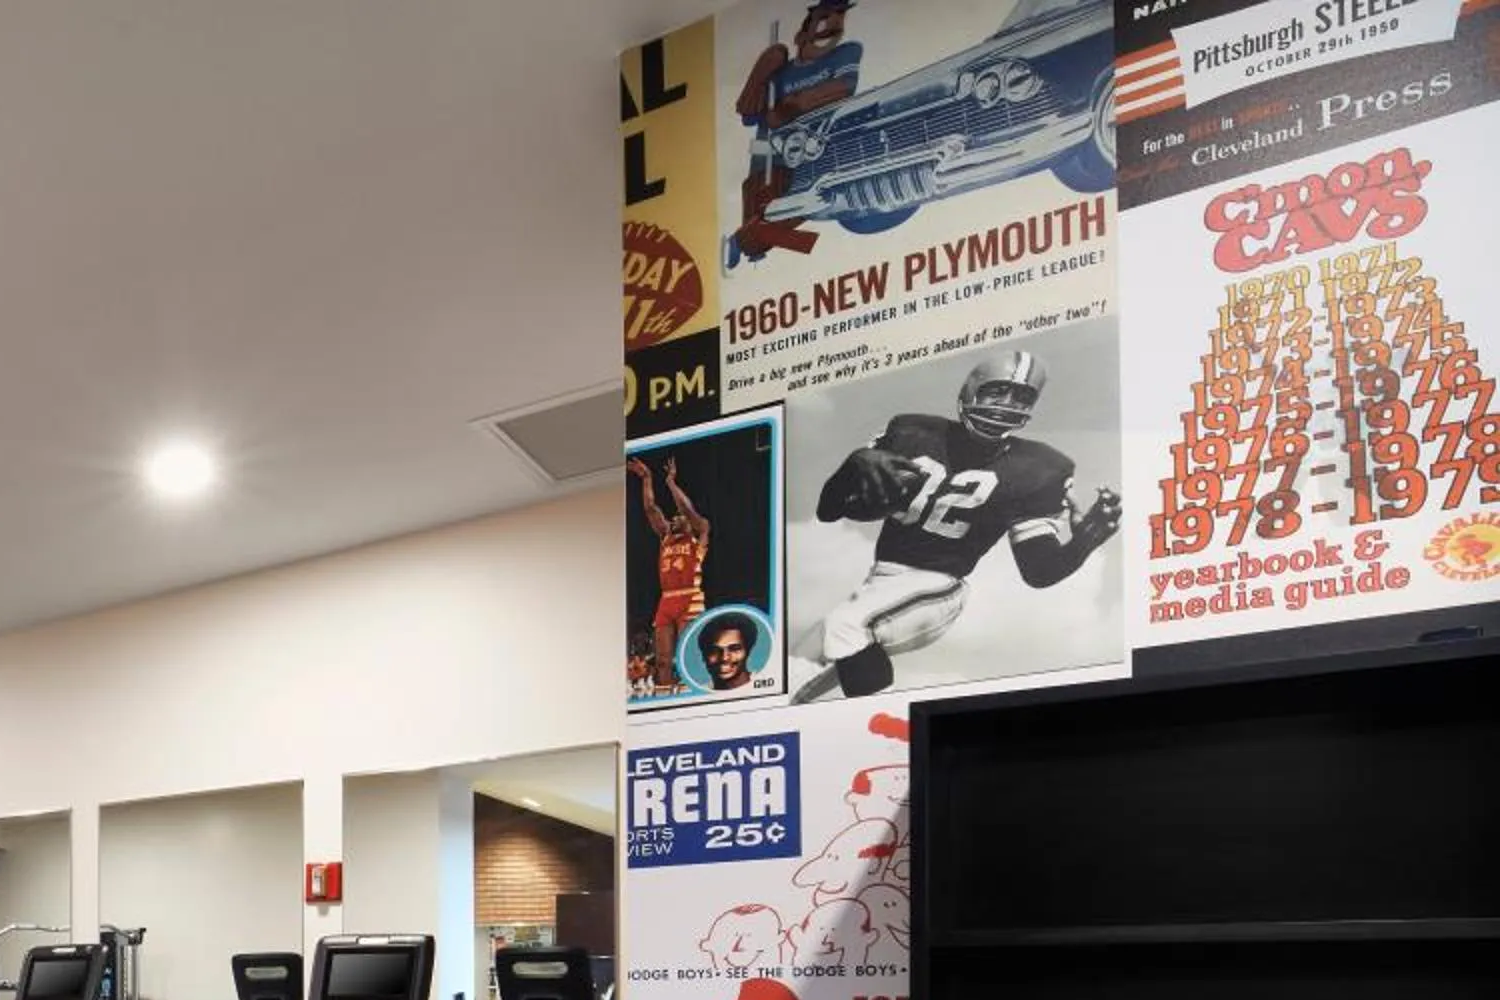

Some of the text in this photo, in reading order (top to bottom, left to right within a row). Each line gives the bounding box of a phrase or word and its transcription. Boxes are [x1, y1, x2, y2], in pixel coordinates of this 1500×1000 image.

[1192, 17, 1304, 74] Pittsburgh
[1245, 47, 1311, 77] OCTOBER
[1318, 34, 1353, 54] 29th
[1191, 119, 1303, 166] Cleveland
[1315, 68, 1454, 131] Press
[1213, 176, 1428, 273] CAVS
[723, 195, 1106, 345] 1960-NEW PLYMOUTH
[726, 346, 757, 365] MOST
[762, 328, 818, 355] EXCITING
[823, 306, 898, 337] PERFORMER
[903, 299, 918, 315] IN
[923, 291, 949, 310] THE
[954, 268, 1035, 301] LOW-PRICE
[649, 364, 716, 411] P.M.
[727, 376, 755, 391] Drive
[769, 367, 787, 382] big
[790, 359, 813, 375] new
[787, 375, 808, 392] and
[811, 370, 831, 386] see
[835, 363, 858, 379] why
[861, 355, 880, 373] it's
[885, 352, 894, 367] 3
[896, 346, 929, 366] years
[933, 330, 970, 354] ahead
[973, 327, 988, 344] of
[991, 323, 1013, 340] the
[1149, 529, 1390, 600] yearbook &
[1149, 561, 1412, 623] media guide
[705, 822, 787, 849] 25¢
[677, 968, 713, 980] BOYS
[725, 965, 749, 979] SEE
[757, 966, 785, 978] THE
[792, 964, 847, 977] DODGE
[855, 964, 898, 977] BOYS
